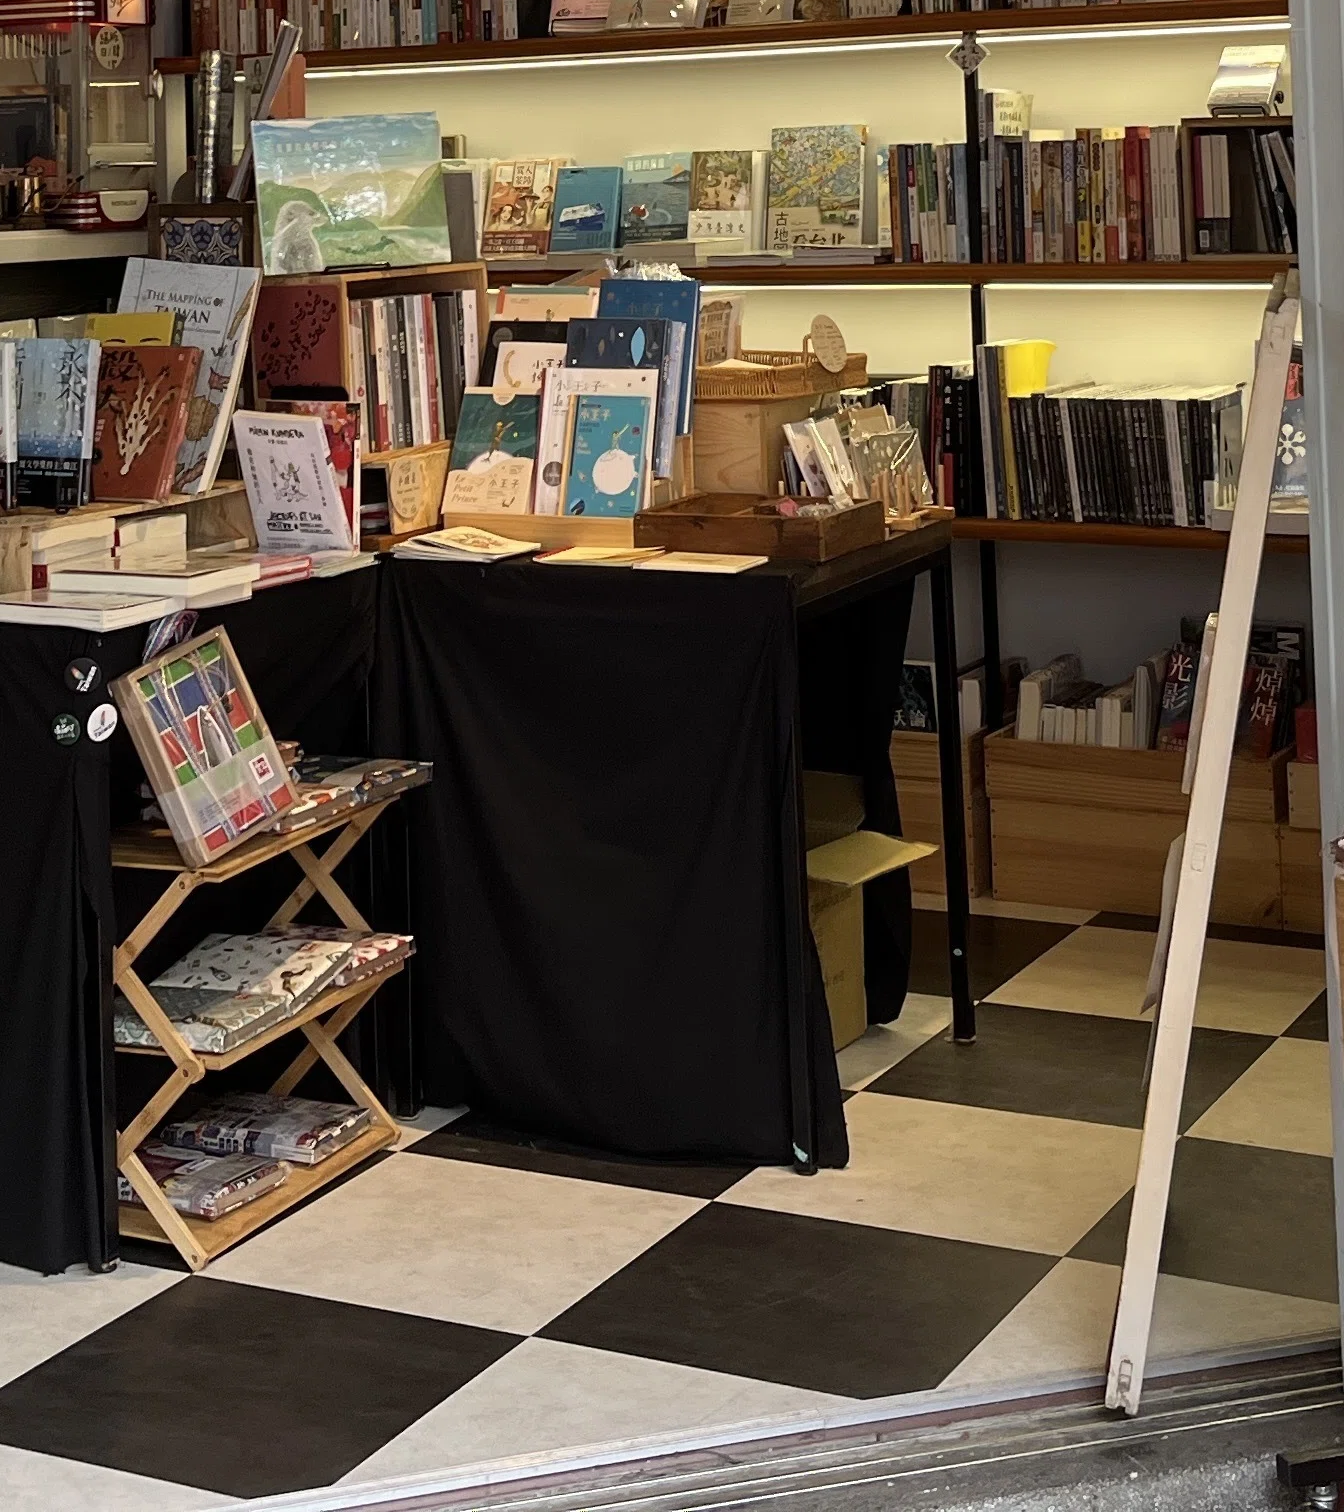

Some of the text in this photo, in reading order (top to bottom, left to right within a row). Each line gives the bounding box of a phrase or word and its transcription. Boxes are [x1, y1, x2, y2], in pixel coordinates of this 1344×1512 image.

[146, 288, 166, 302] THE
[168, 291, 212, 306] MAPPING
[155, 304, 212, 325] TAWAN
[1162, 653, 1194, 711] 光影
